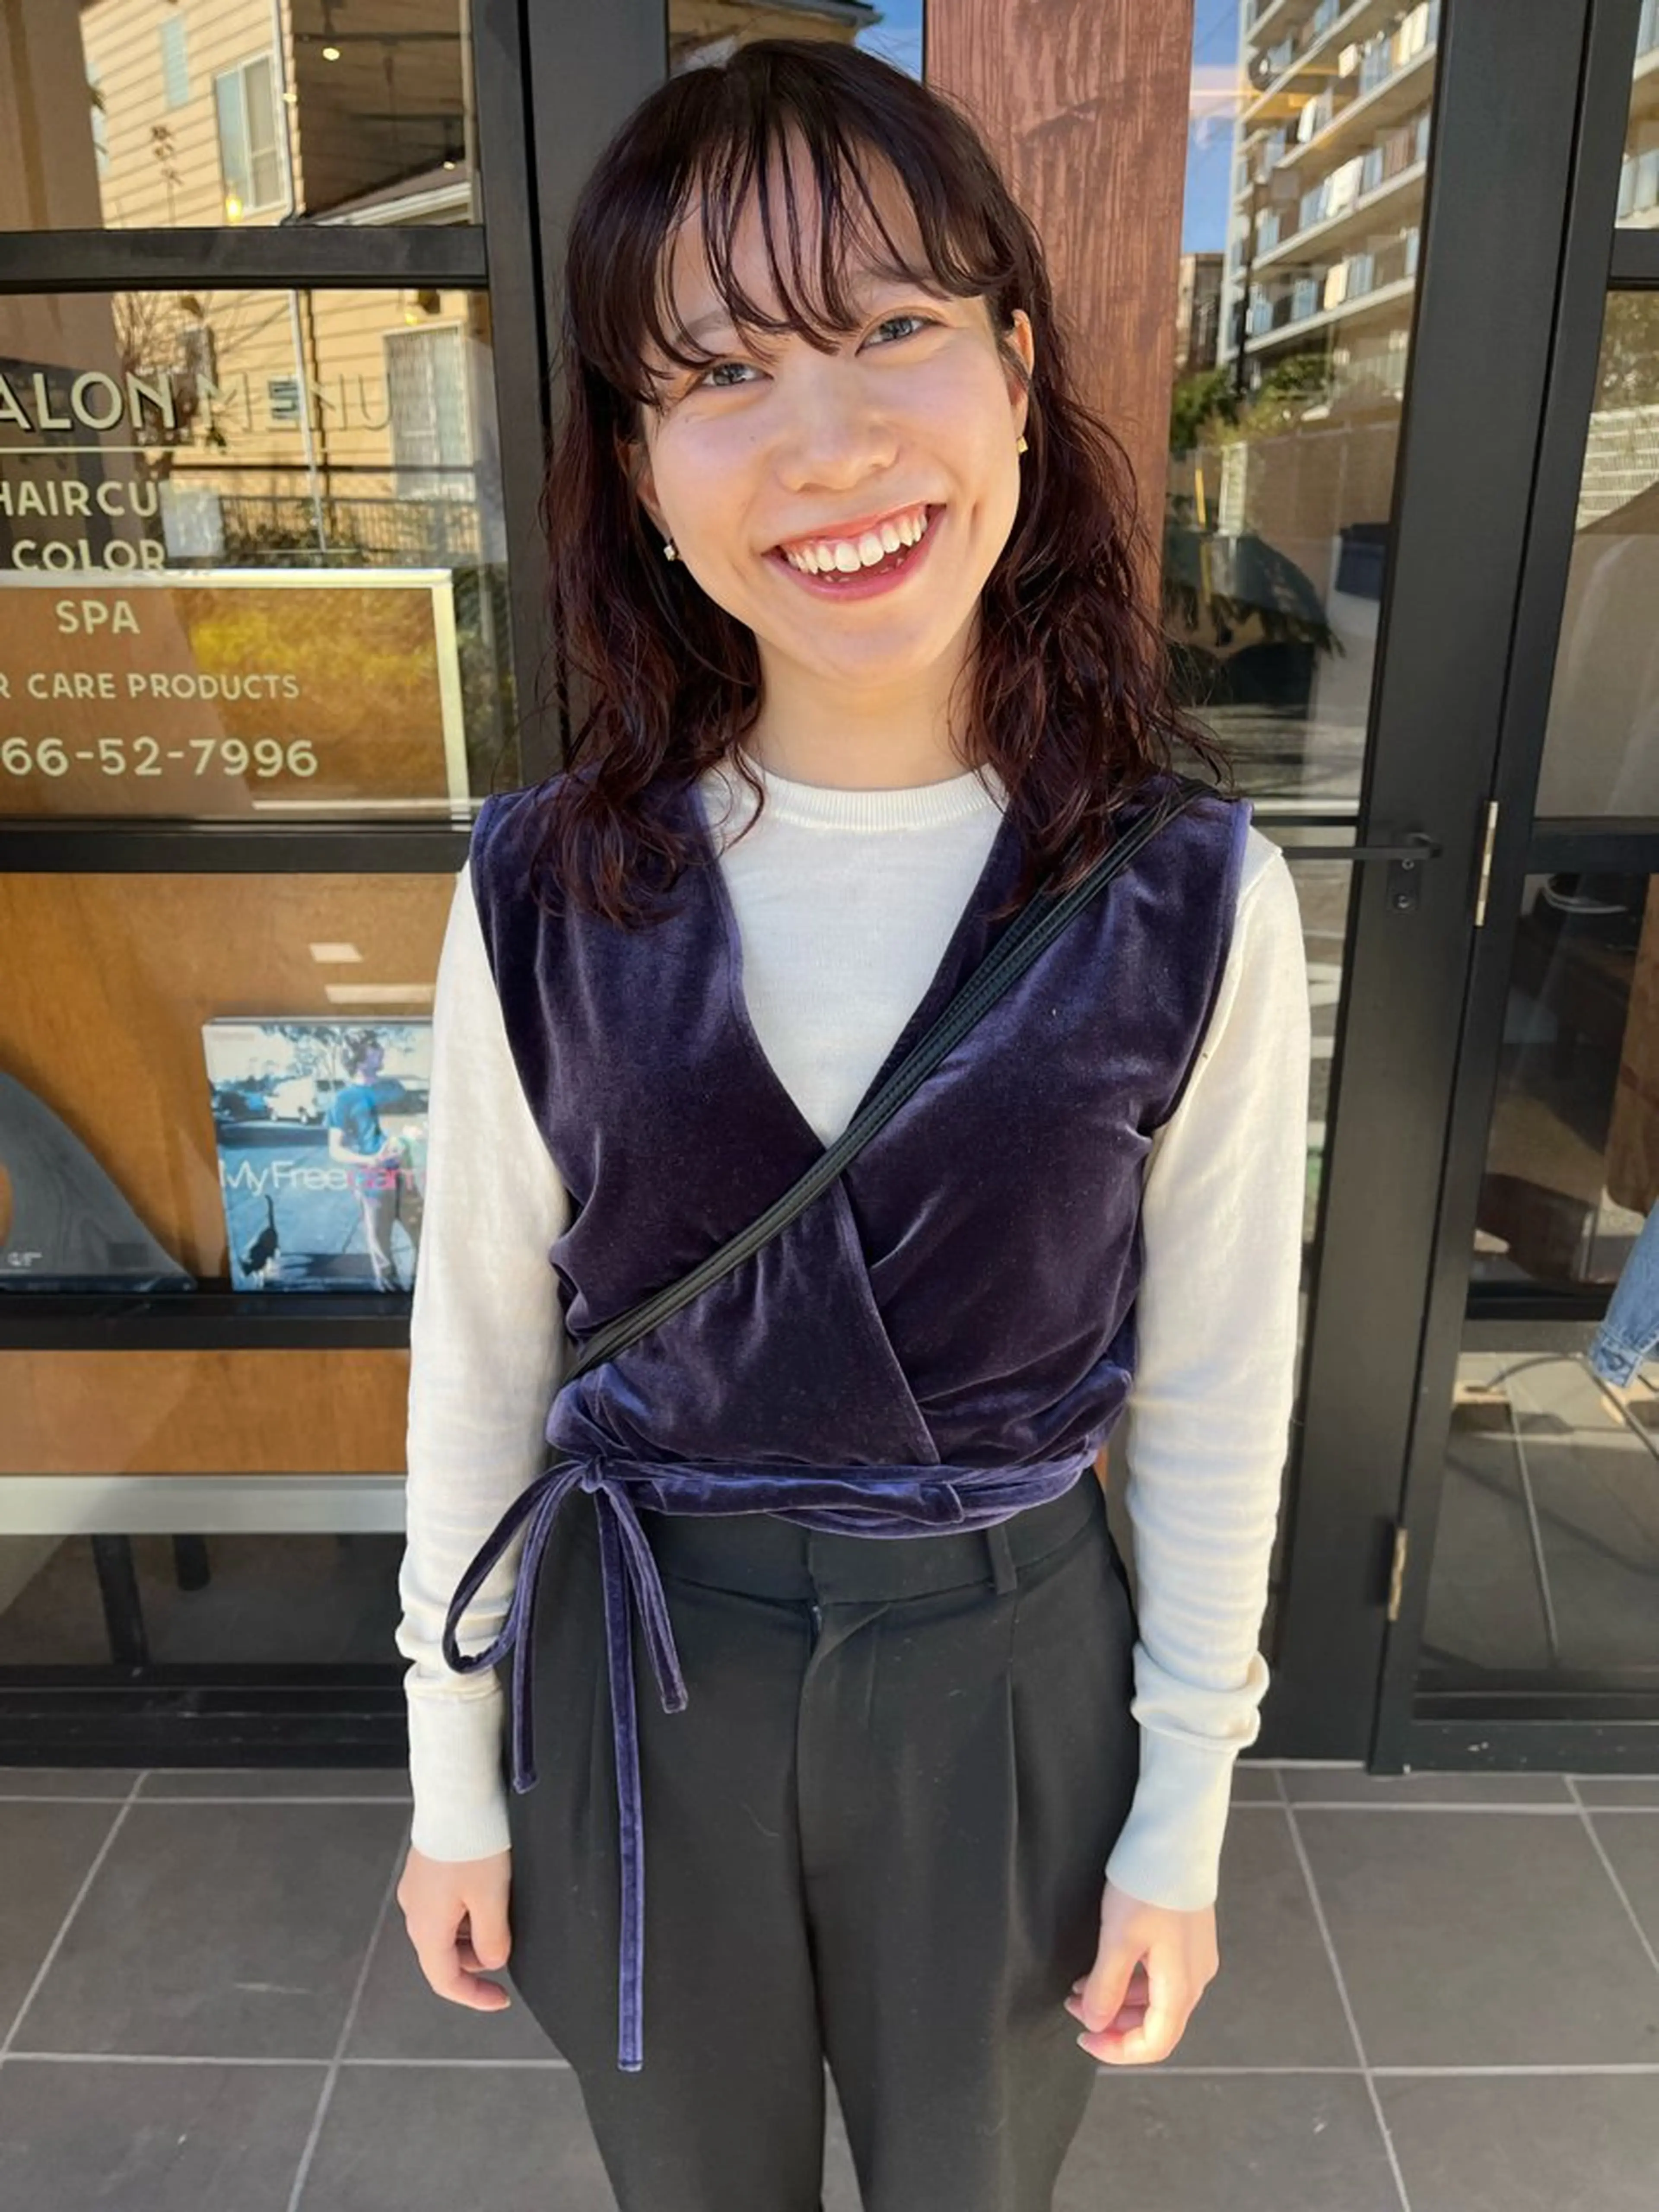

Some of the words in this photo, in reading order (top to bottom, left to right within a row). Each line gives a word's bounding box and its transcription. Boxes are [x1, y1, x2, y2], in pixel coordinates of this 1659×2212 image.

[0, 480, 169, 516] HAIRCU
[12, 539, 166, 570] COLOR
[56, 600, 141, 634] SPA
[28, 672, 117, 699] CARE
[127, 673, 300, 700] PRODUCTS
[1, 736, 318, 777] 66-52-7996
